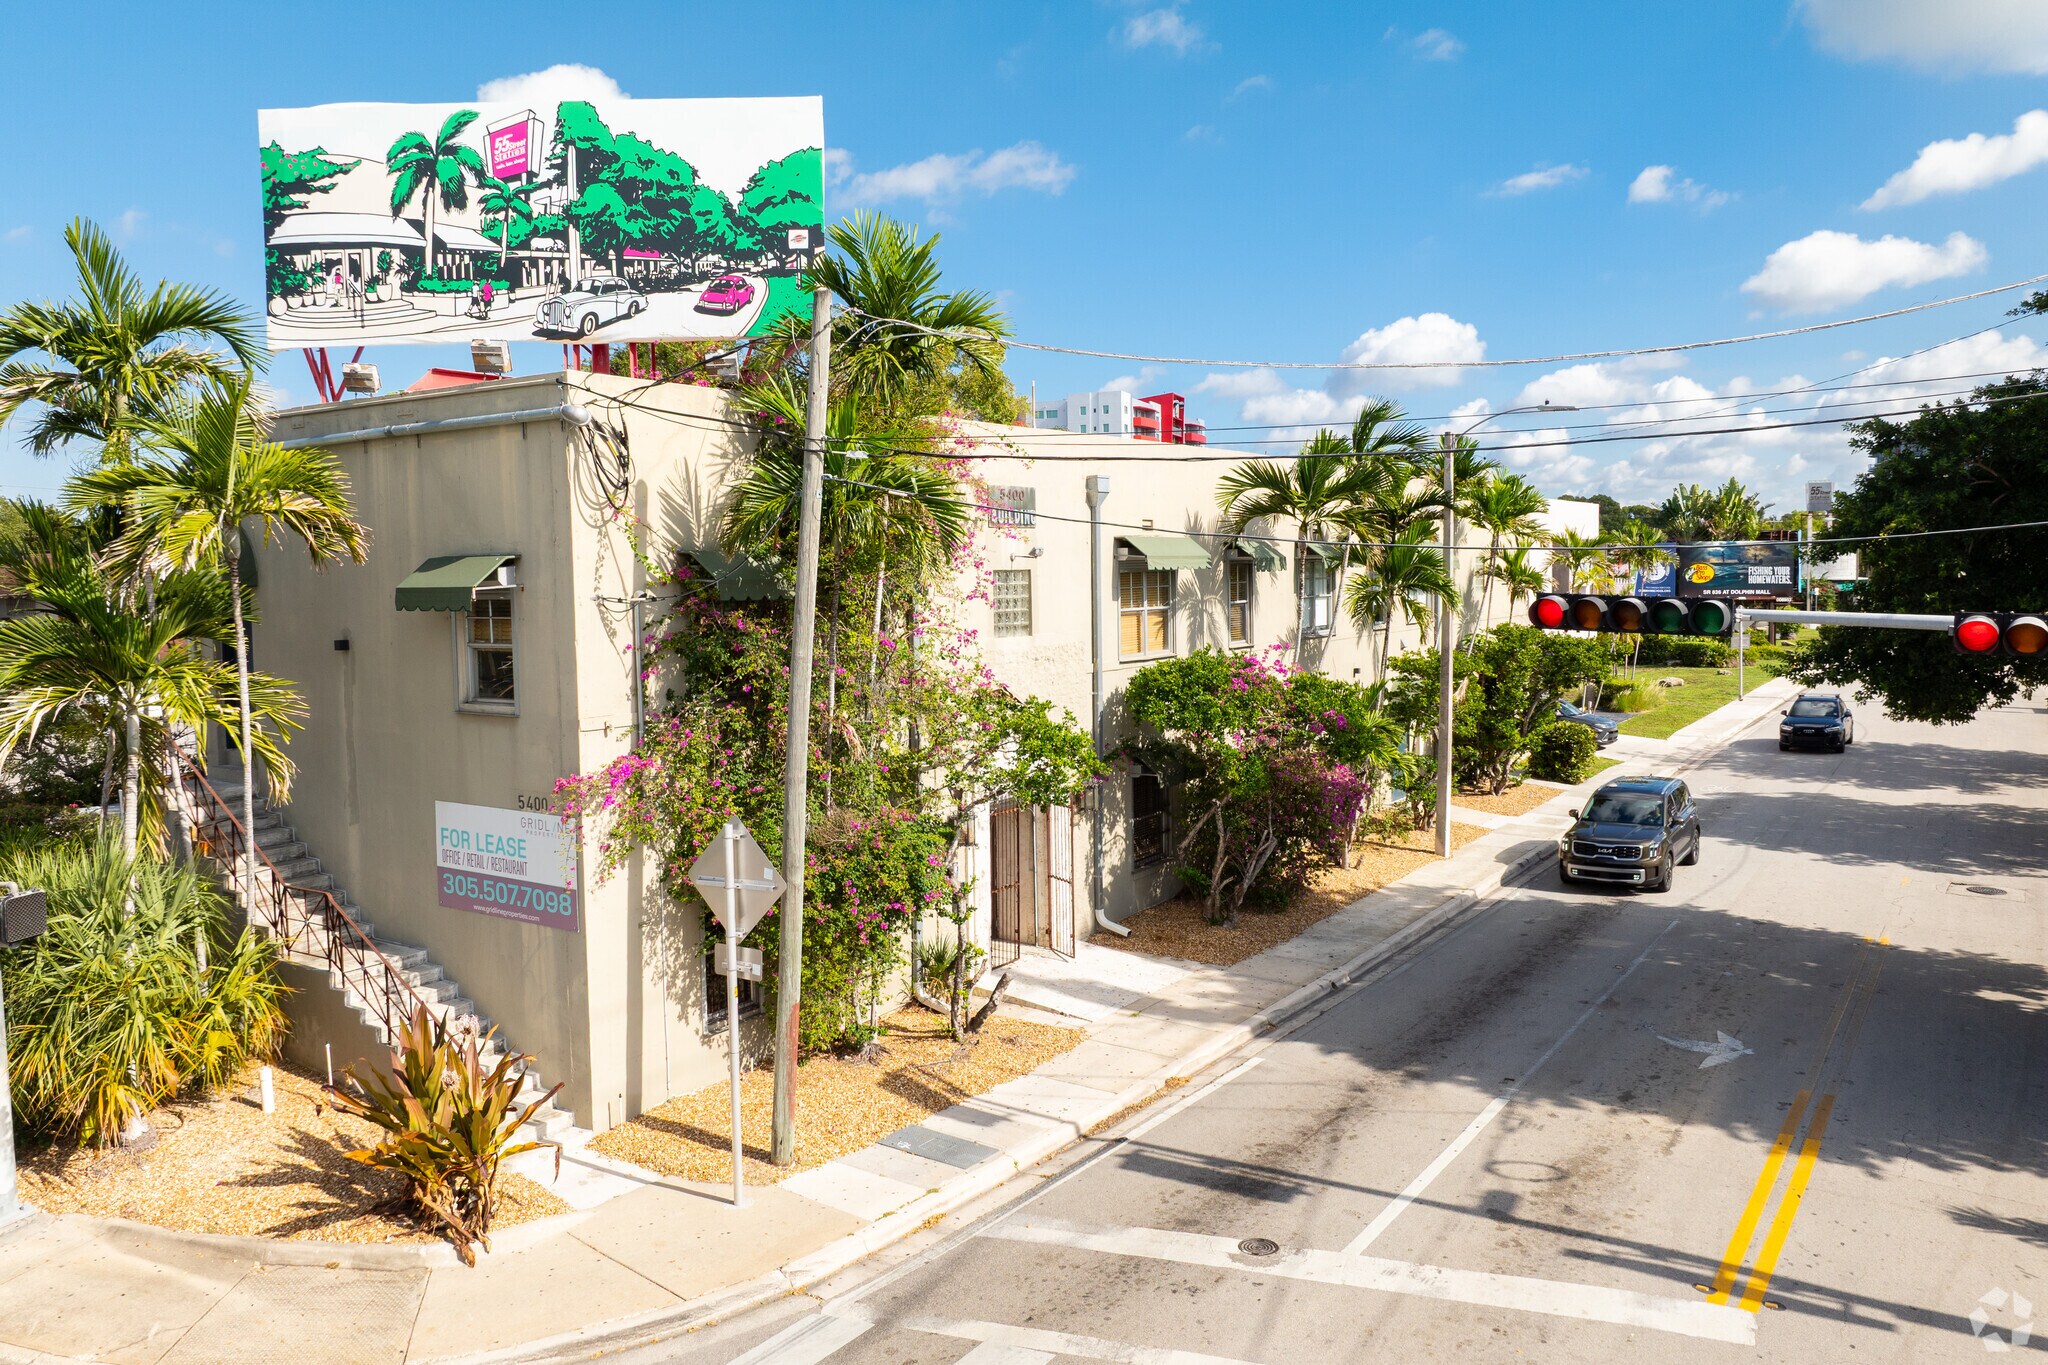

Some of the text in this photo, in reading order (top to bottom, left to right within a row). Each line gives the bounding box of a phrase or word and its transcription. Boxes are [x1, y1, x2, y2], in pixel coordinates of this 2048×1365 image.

[494, 134, 513, 154] 55
[1000, 489, 1024, 501] 5400
[1748, 567, 1790, 575] FISHING YOUR
[1748, 576, 1792, 584] HOMEWATERS.
[518, 795, 548, 811] 5400
[441, 828, 526, 858] FOR LEASE
[442, 849, 461, 866] OFFICE
[467, 852, 485, 870] RETAIL
[491, 856, 528, 876] RESTAURANT
[443, 873, 572, 916] 305.507.7098
